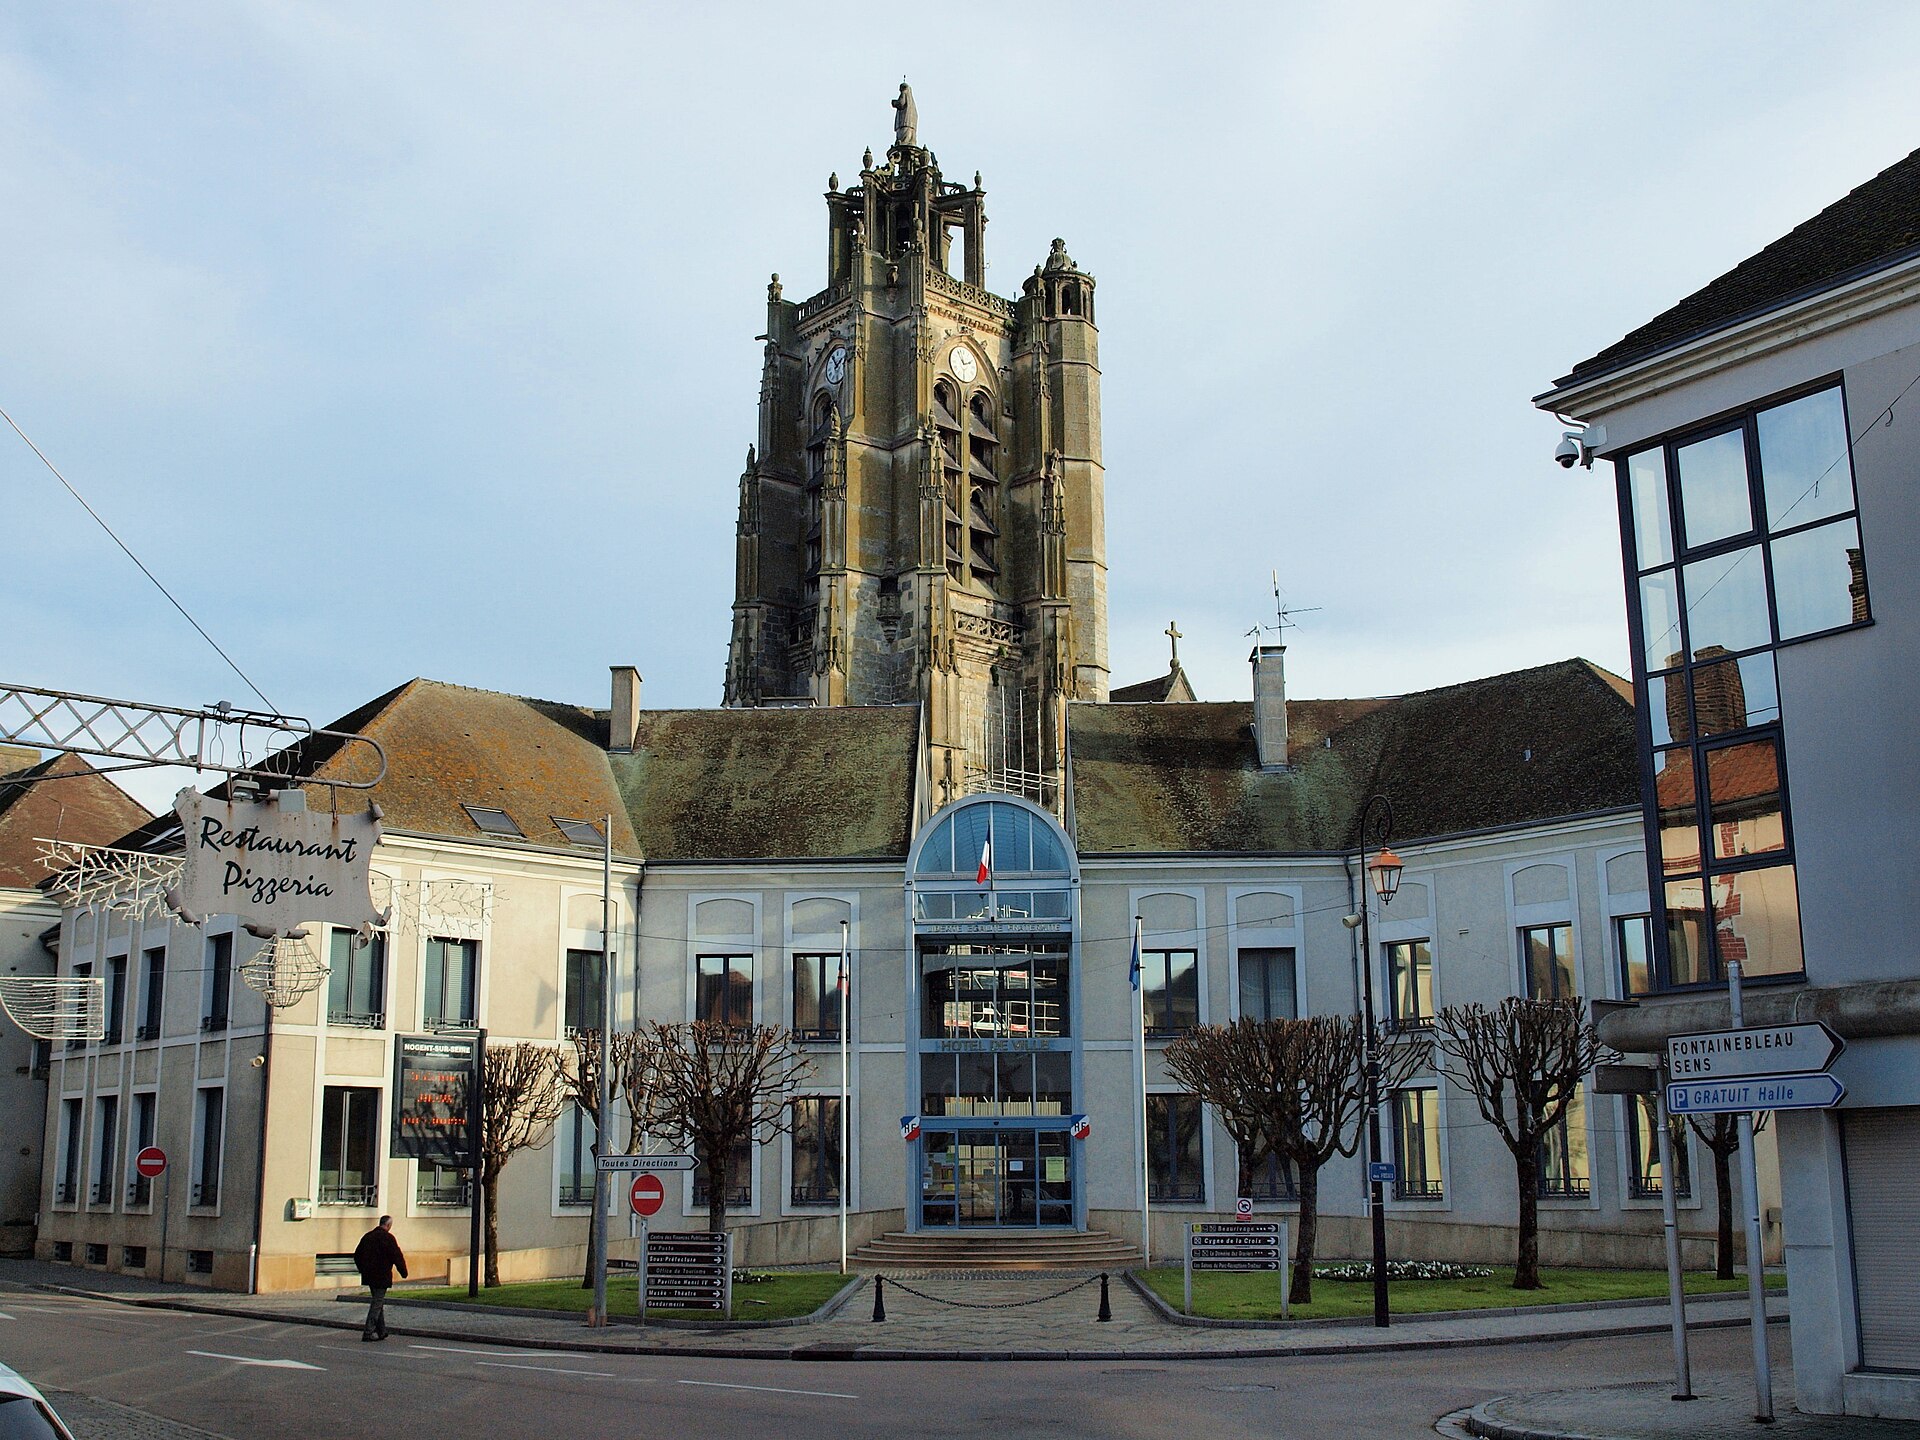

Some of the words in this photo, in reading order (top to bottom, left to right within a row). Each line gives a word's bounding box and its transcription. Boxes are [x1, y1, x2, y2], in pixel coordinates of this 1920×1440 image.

[200, 816, 357, 863] Restaurant
[223, 860, 334, 904] Pizzeria
[404, 1043, 470, 1054] NOGENT-SUR-SEINE
[991, 1040, 1008, 1051] DE
[1012, 1040, 1050, 1051] VILLE
[1672, 1032, 1793, 1056] FONTAINEBLEAU
[1674, 1058, 1712, 1073] SENS
[1694, 1088, 1750, 1104] GRATUIT
[1759, 1085, 1794, 1101] Halle
[601, 1159, 629, 1167] Toutes
[632, 1159, 678, 1167] Directions
